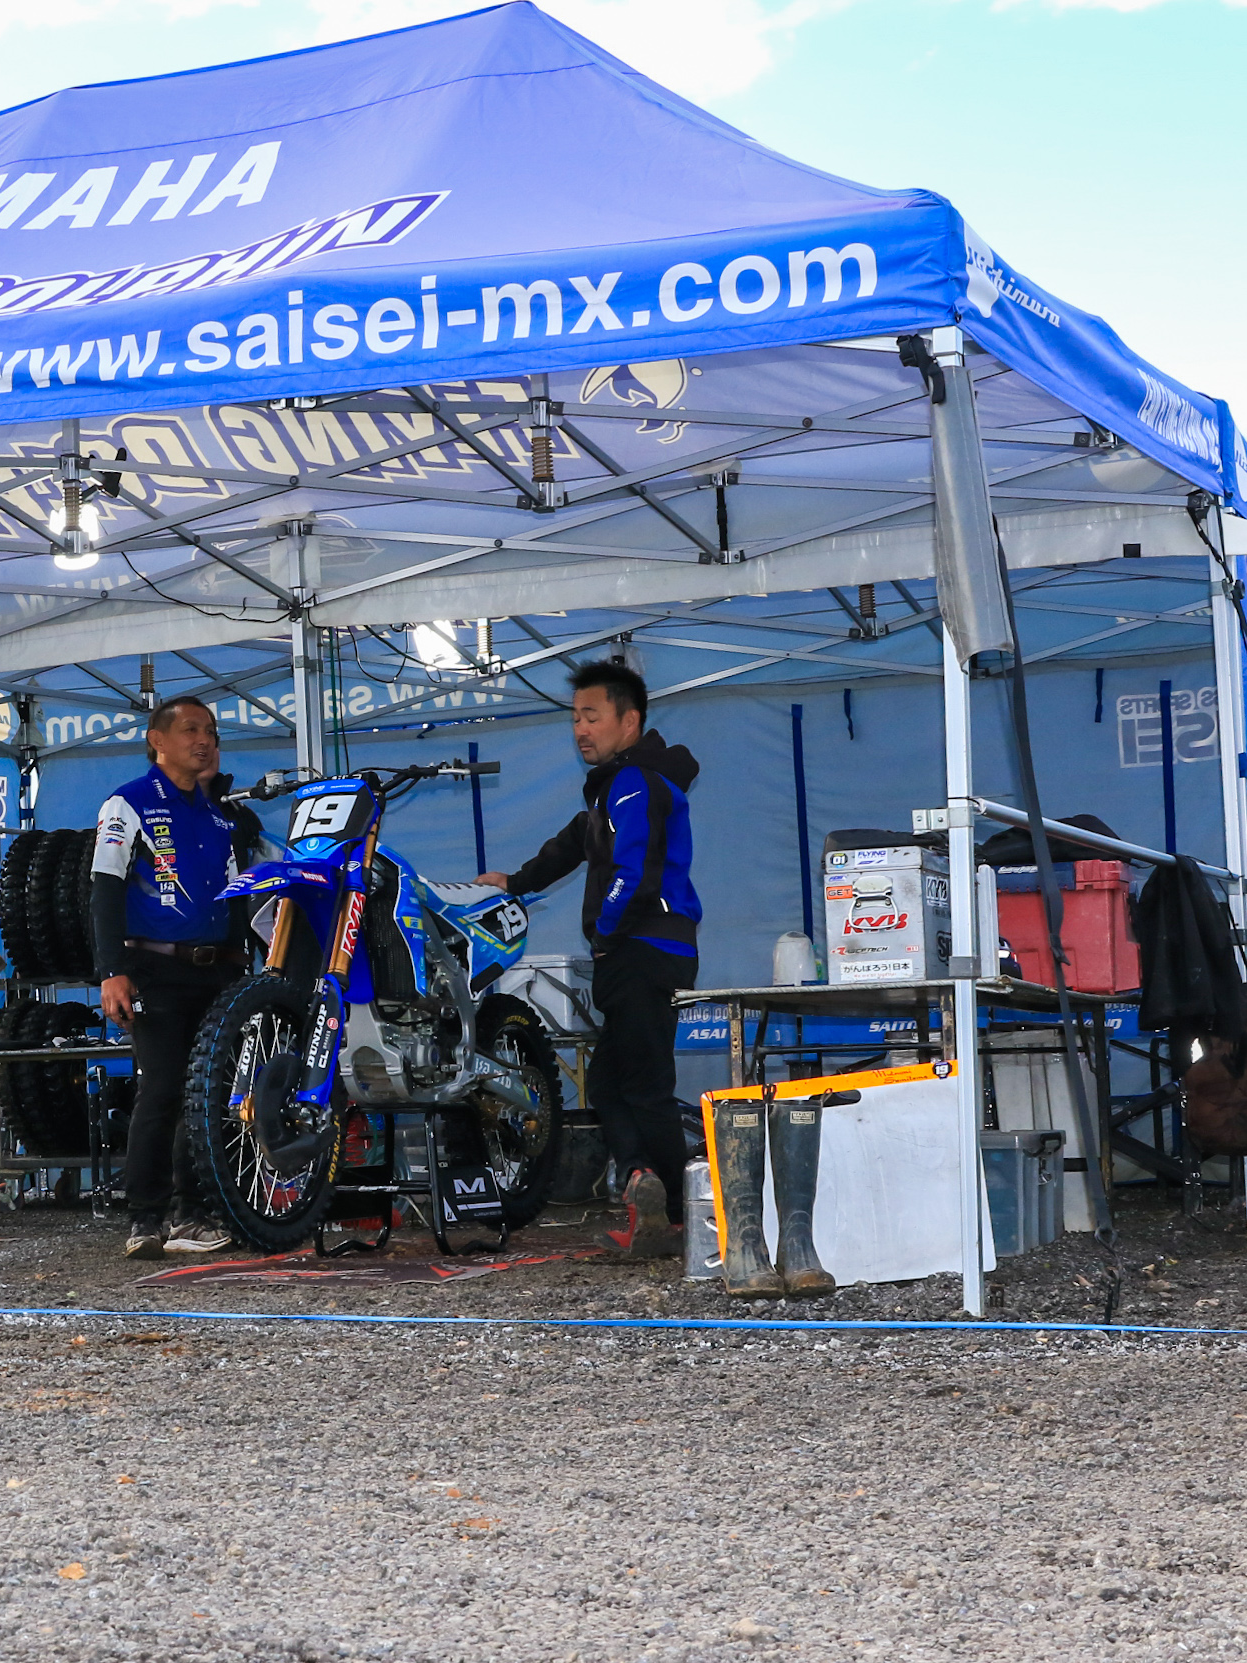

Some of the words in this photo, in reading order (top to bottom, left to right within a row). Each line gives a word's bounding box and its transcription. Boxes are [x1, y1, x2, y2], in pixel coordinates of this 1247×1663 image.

[289, 794, 358, 841] 19
[827, 888, 852, 898] GET
[496, 902, 528, 943] 19
[843, 912, 909, 936] KYB
[306, 1003, 328, 1069] DUNLOP
[687, 1028, 728, 1040] ASAI
[318, 1050, 330, 1069] CL
[934, 1063, 949, 1075] 19
